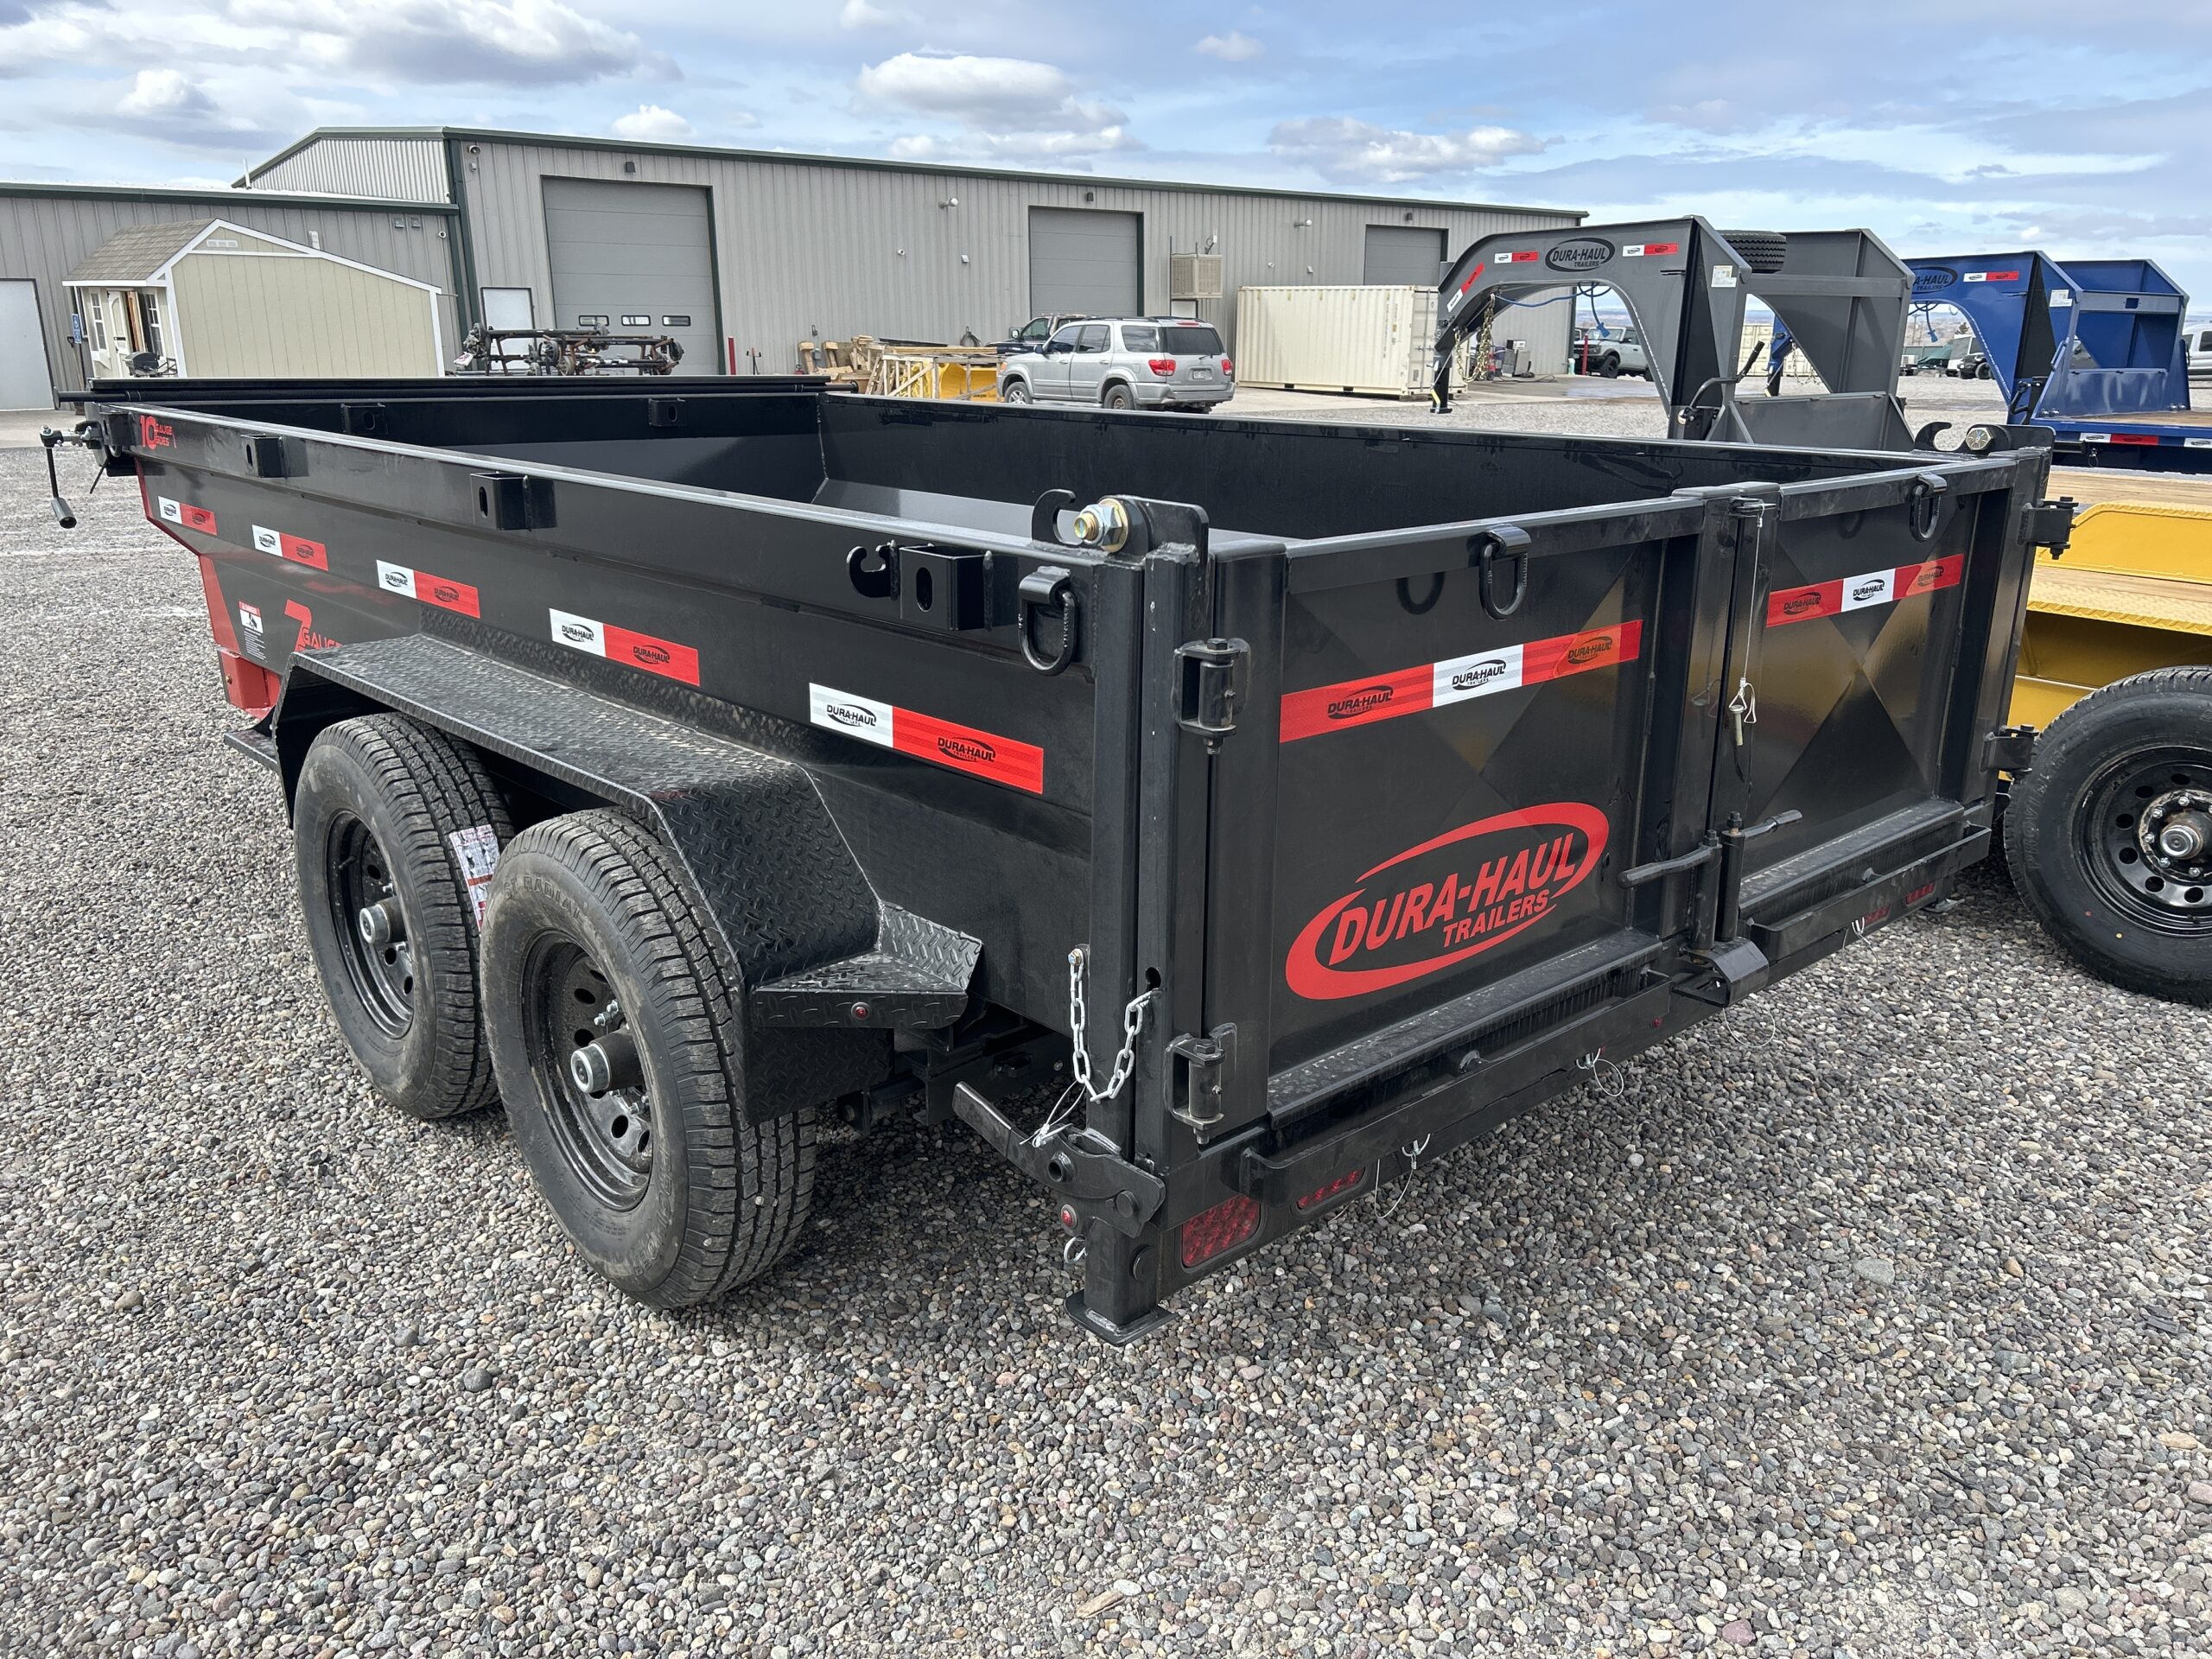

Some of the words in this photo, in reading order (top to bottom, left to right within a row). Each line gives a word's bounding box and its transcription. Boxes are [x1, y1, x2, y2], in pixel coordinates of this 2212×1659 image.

[1552, 247, 1606, 262] DURA-HAUL
[1912, 274, 1950, 286] A-HAUL
[140, 414, 156, 449] 10
[1853, 583, 1884, 597] DURA-HAUL
[283, 598, 313, 652] 7
[302, 627, 343, 650] GAUG
[562, 625, 594, 641] DURA-HAUL
[632, 645, 671, 664] DURA-HAUL
[1567, 641, 1611, 659] DURA-HAUL
[1452, 665, 1505, 685] DURA-HAUL
[1327, 691, 1392, 714] DURA-HAUL
[826, 704, 876, 727] DURA-HAUL
[938, 737, 995, 762] DURA-HAUL
[1328, 832, 1574, 966] DURA-HAUL
[1443, 888, 1550, 948] TRAILERS
